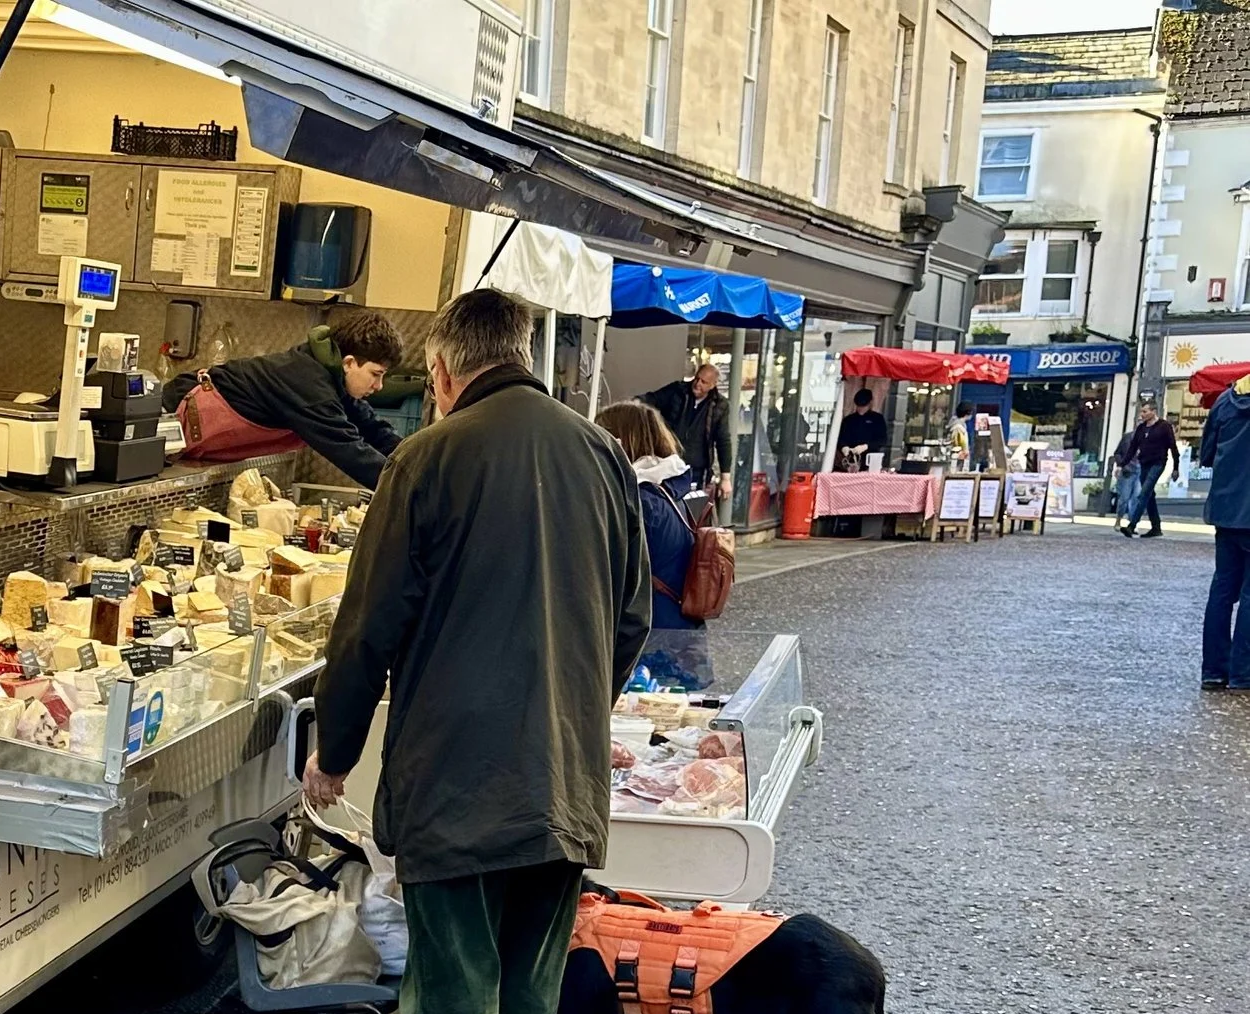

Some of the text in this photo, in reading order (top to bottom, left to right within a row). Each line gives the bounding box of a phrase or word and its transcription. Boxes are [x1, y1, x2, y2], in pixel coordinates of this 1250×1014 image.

[678, 292, 712, 314] MARKET
[1037, 351, 1121, 369] BOOKSHOP
[78, 881, 92, 904] Tel:
[94, 863, 122, 898] (01453)
[124, 845, 149, 876] 884320
[155, 838, 174, 857] Mob:
[14, 904, 60, 942] CHEESEMONGERS
